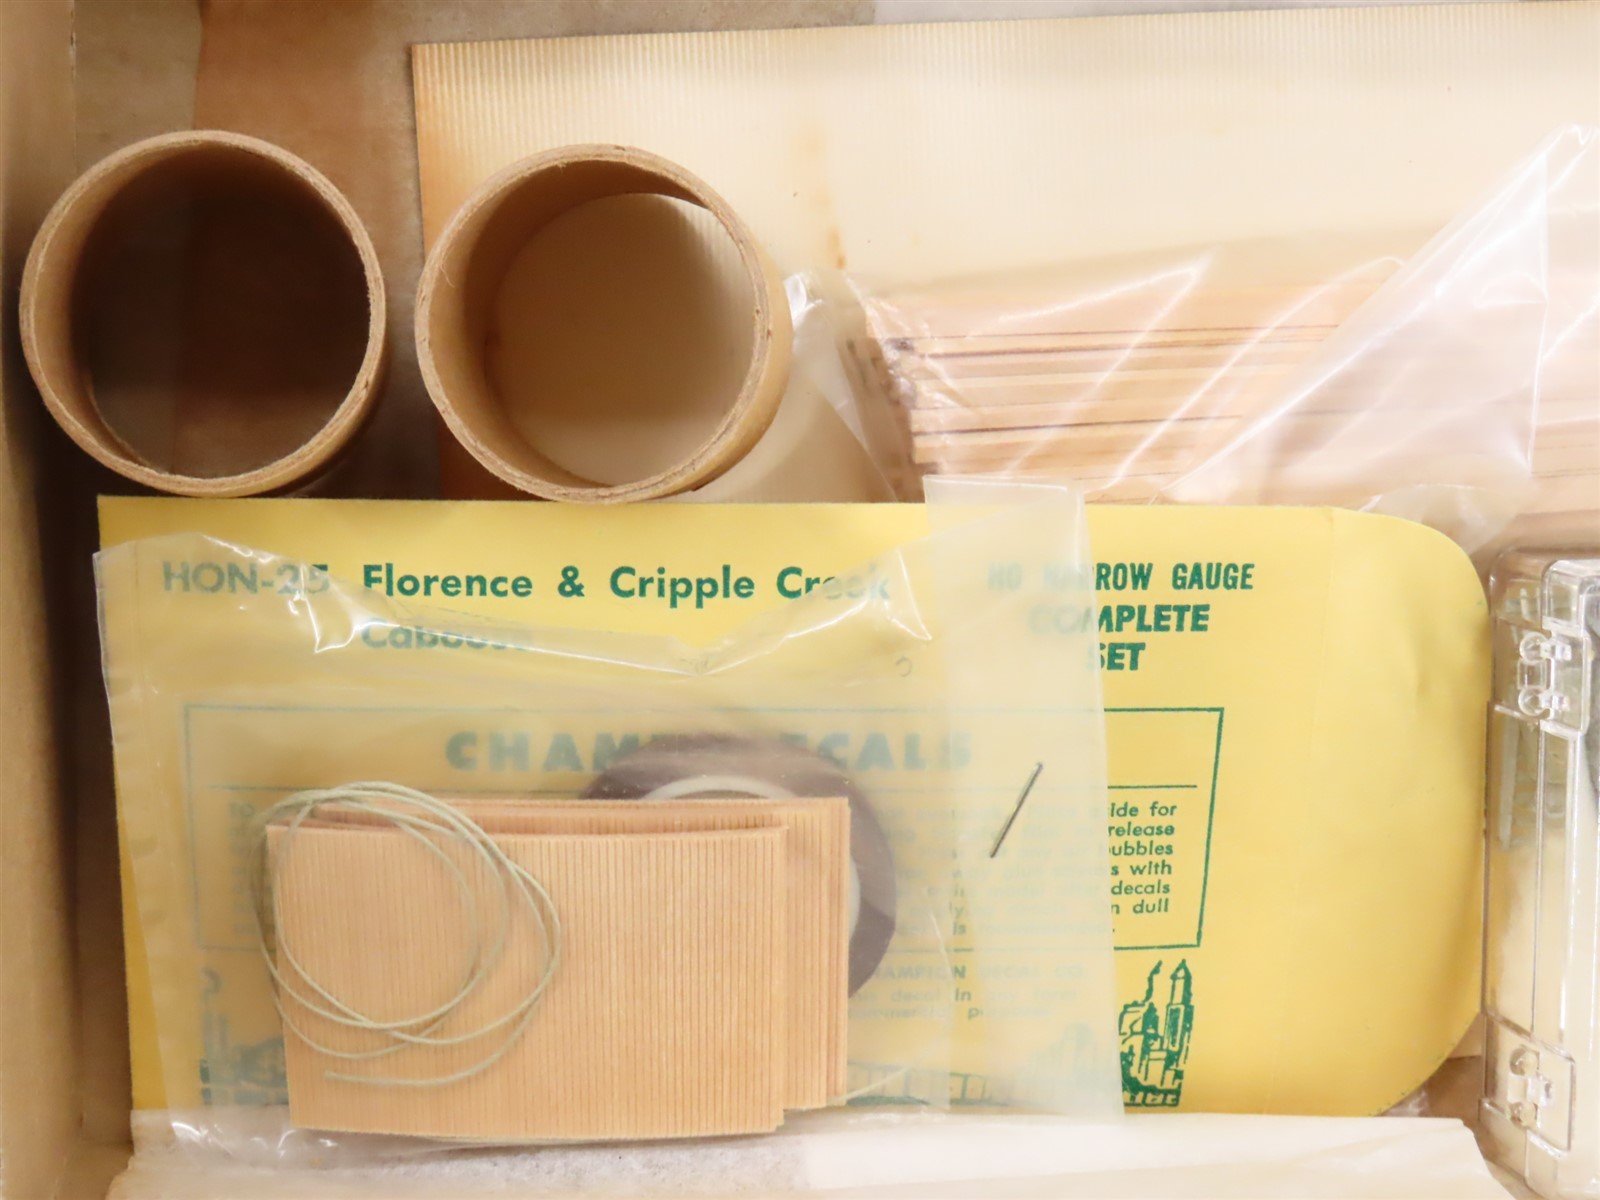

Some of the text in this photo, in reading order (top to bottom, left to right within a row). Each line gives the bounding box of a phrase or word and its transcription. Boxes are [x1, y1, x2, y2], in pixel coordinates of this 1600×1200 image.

[163, 561, 329, 594] HON-25
[363, 563, 534, 598] Florence
[557, 564, 586, 597] &
[609, 564, 756, 609] Cripple
[1171, 562, 1256, 591] GAUGE
[1087, 642, 1147, 672] SET
[446, 730, 685, 773] CHAM
[1149, 800, 1178, 817] for
[1107, 821, 1176, 838] release
[1108, 839, 1174, 856] ubbles
[1129, 859, 1173, 876] with
[1110, 879, 1171, 896] decals
[1132, 897, 1170, 914] dull
